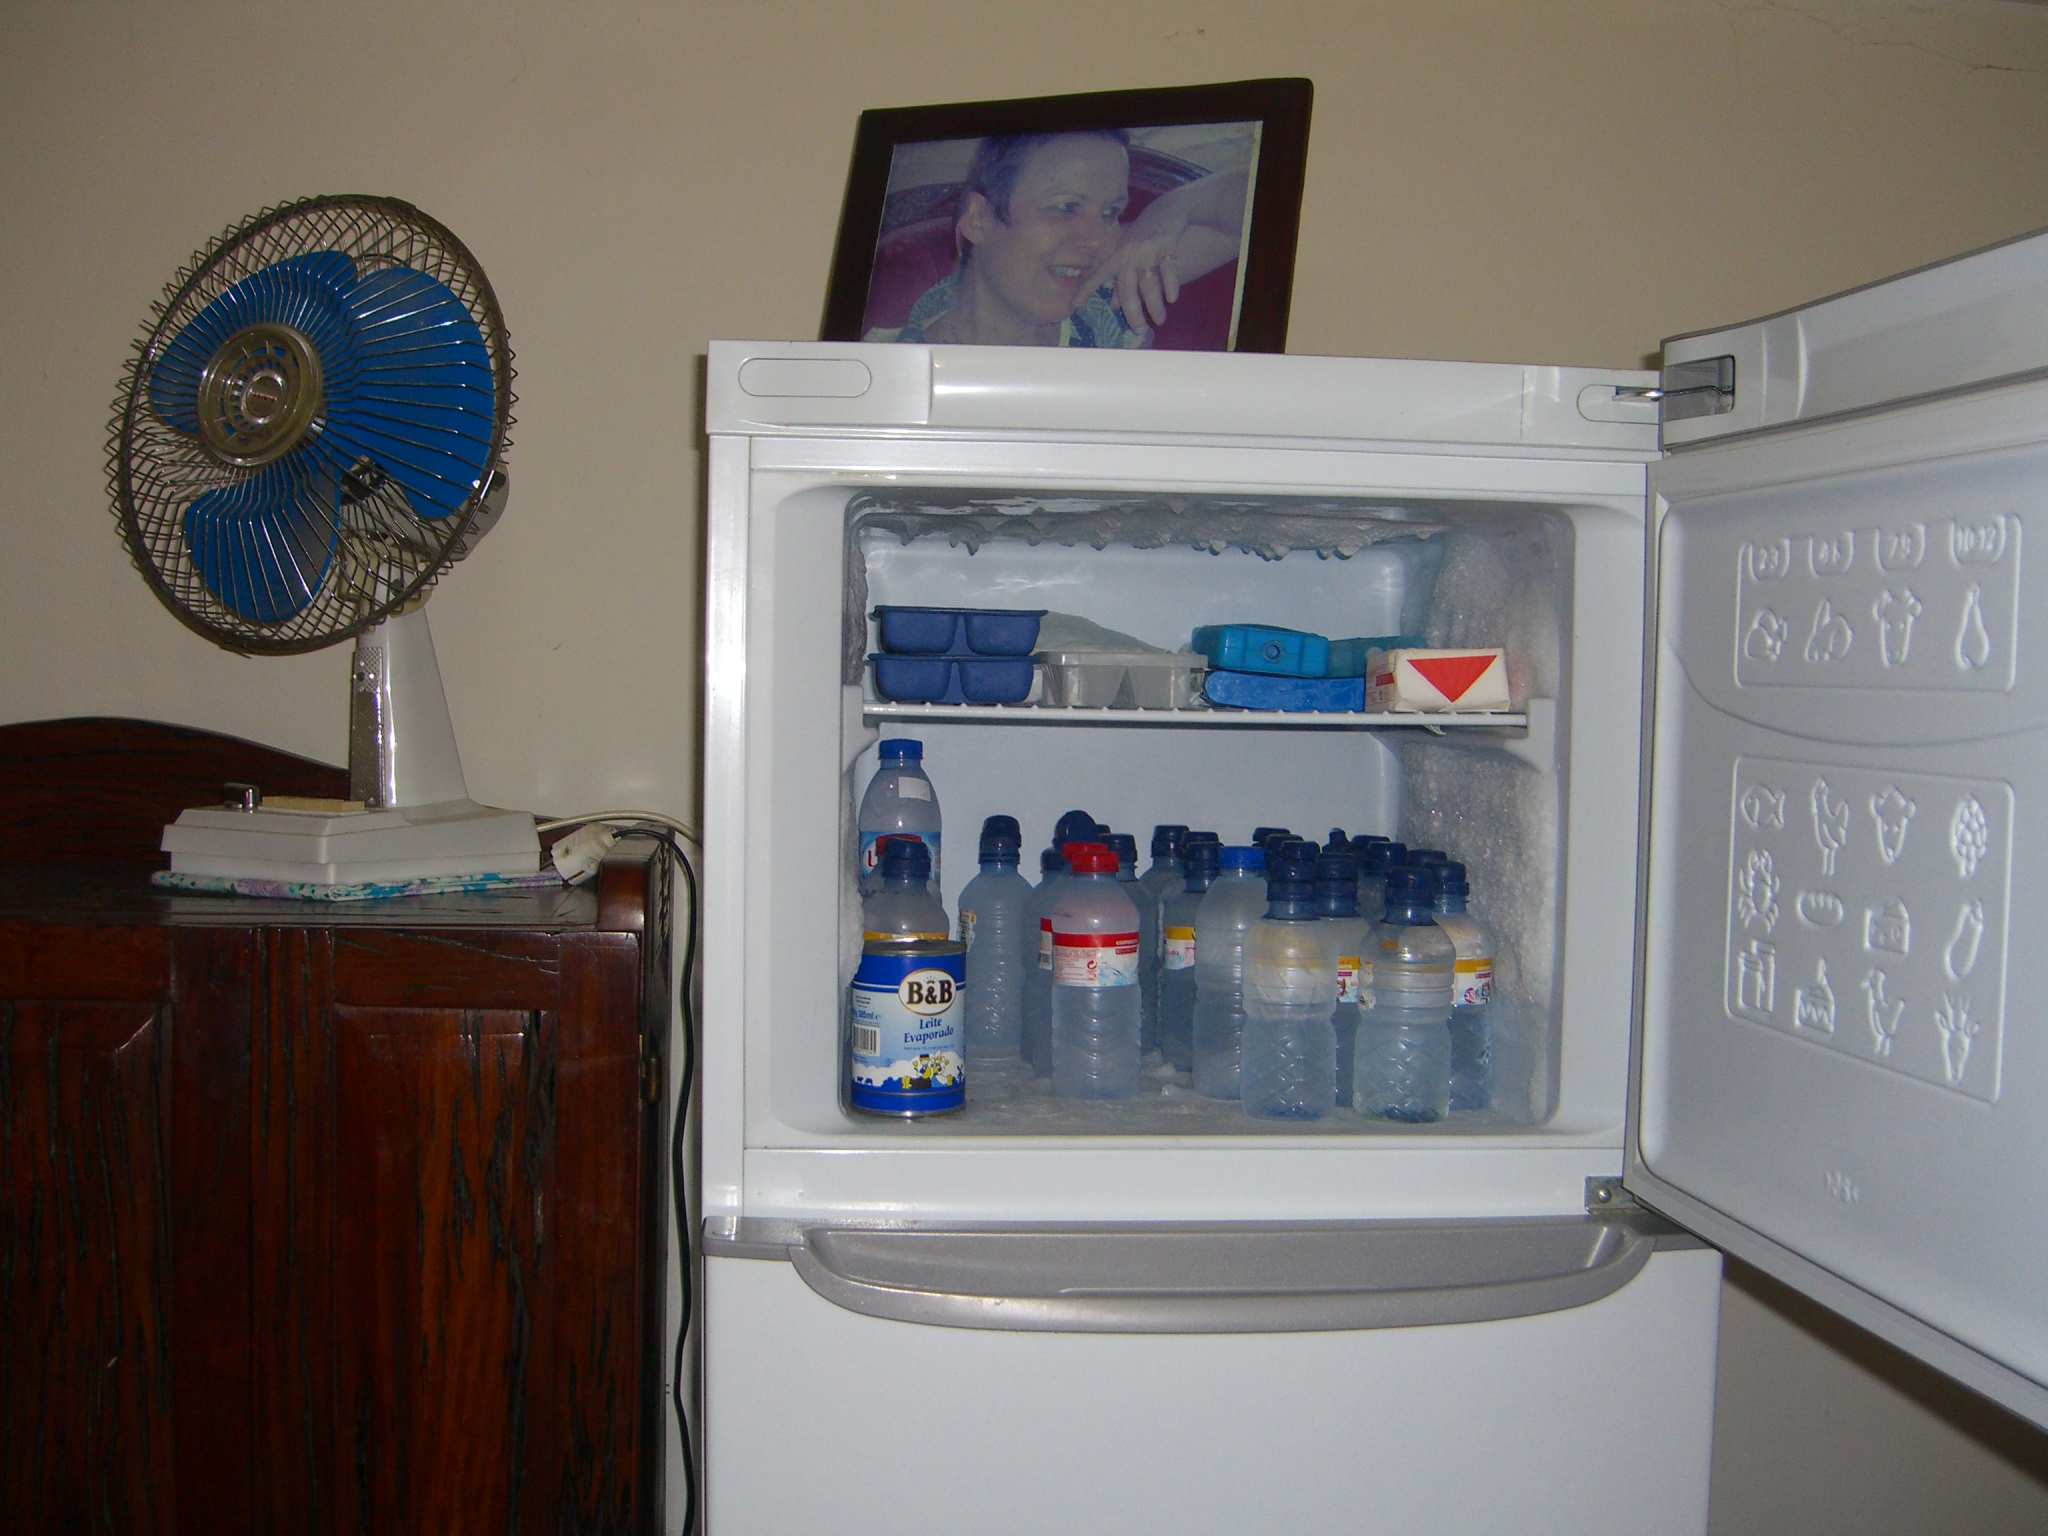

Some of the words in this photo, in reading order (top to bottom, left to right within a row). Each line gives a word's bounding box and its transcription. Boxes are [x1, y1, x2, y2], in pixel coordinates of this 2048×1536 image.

[906, 979, 953, 1005] B&B
[919, 1017, 943, 1030] Leite
[903, 1025, 954, 1044] Evaporado
